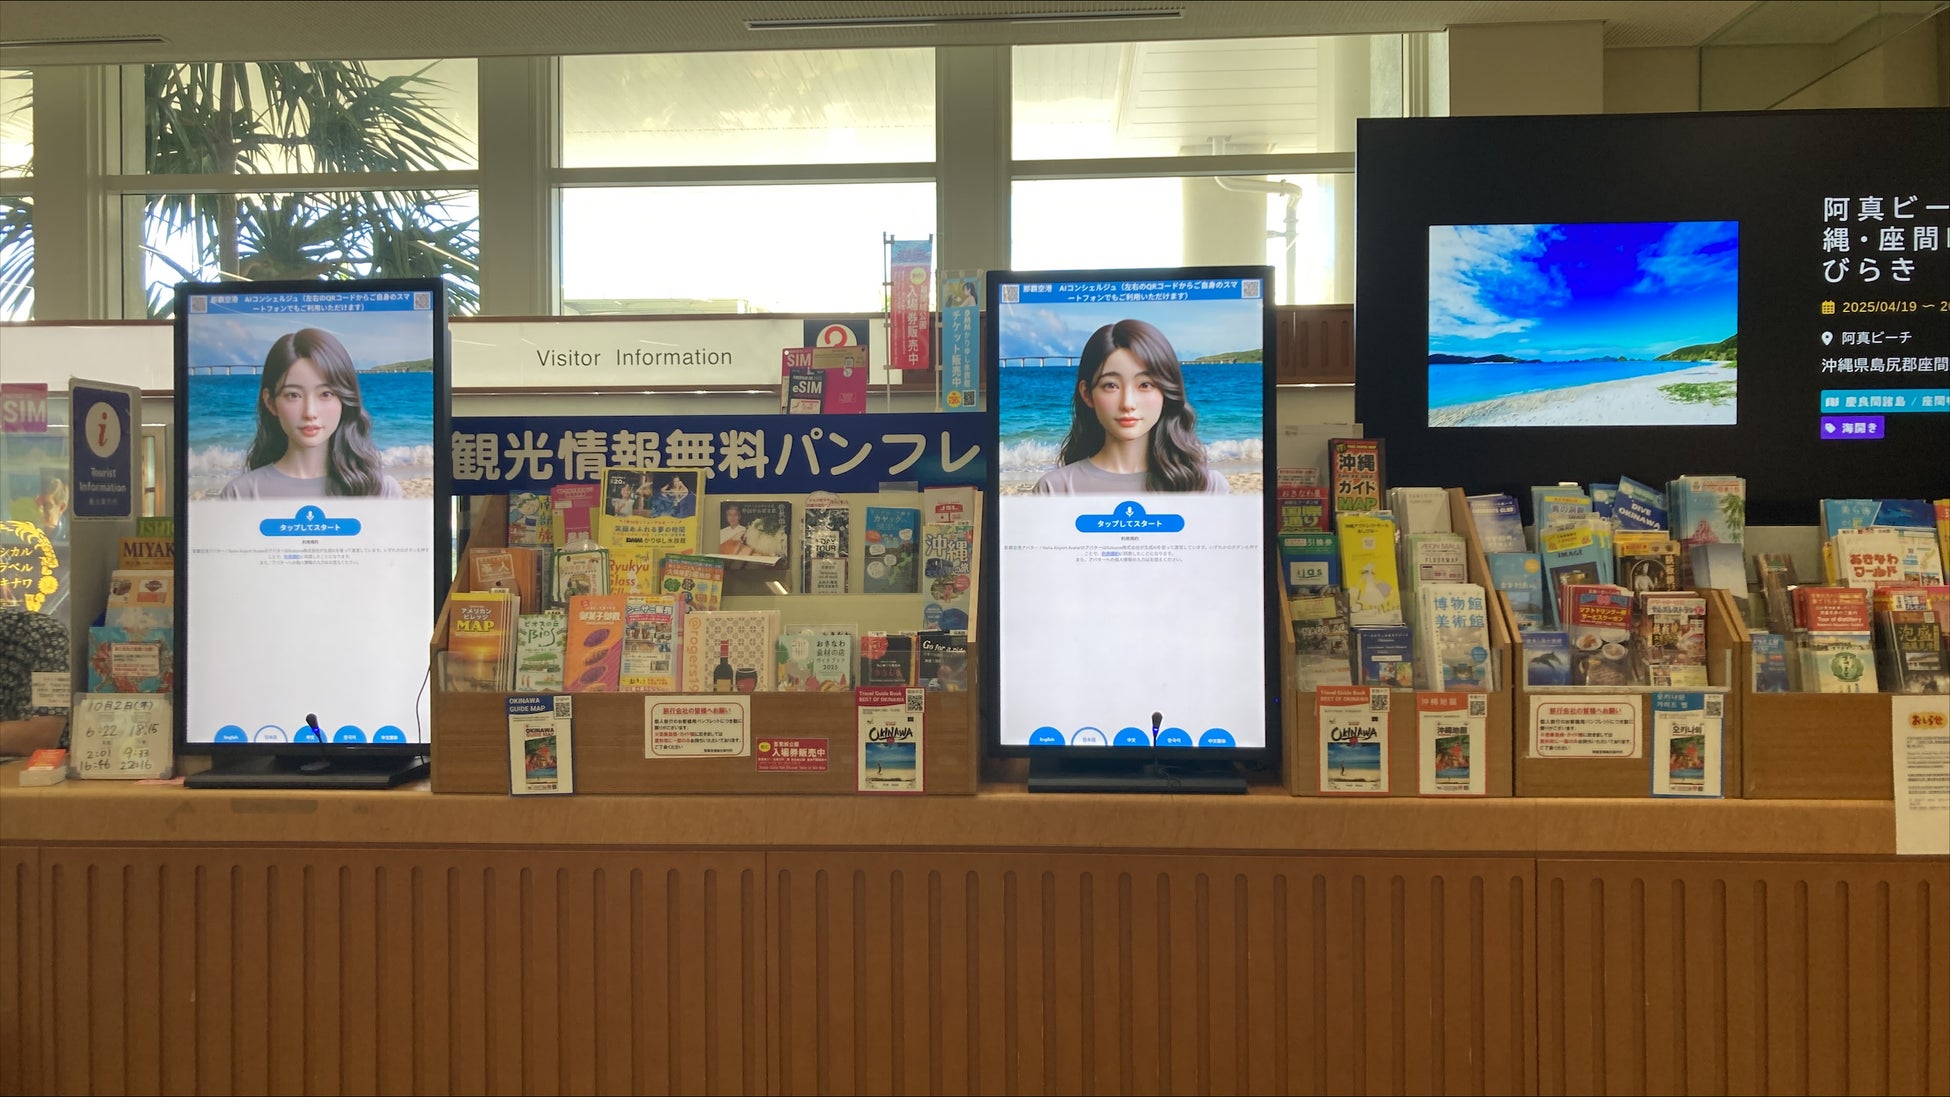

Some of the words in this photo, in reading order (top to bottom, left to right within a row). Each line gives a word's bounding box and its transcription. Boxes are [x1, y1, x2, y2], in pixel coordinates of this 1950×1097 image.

[1824, 195, 1950, 222] 阿真ビー
[1822, 226, 1950, 253] 縄・座間
[1822, 257, 1916, 283] びらき
[1842, 301, 1918, 314] 2025/04/19
[1940, 300, 1950, 312] 2
[907, 285, 919, 365] 入場券販売中
[1842, 331, 1912, 345] 阿真ビーチ
[952, 310, 961, 387] チケット販売中
[536, 350, 600, 366] Visitor
[616, 348, 732, 366] Information
[787, 354, 812, 367] SIM
[792, 381, 822, 394] eSIM
[1845, 396, 1906, 408] 慶良間諸島
[1922, 395, 1950, 407] 座間
[3, 396, 47, 422] SIM
[1842, 422, 1878, 434] 海開き
[451, 427, 981, 481] 観光情報無料パンフレ
[1339, 454, 1376, 472] 沖縄
[90, 467, 116, 478] Tourist
[80, 482, 126, 492] Information
[1338, 480, 1376, 495] ガイド
[1338, 496, 1378, 512] MAP
[1631, 502, 1652, 516] DIVE
[1097, 520, 1163, 528] タップしてスタート
[1618, 507, 1660, 530] OKINAWA
[280, 524, 342, 532] タップしてスタート
[816, 544, 836, 552] TOUR
[925, 534, 968, 562] 沖縄
[1850, 553, 1900, 565] おきなわ
[610, 560, 649, 575] Ryukyu
[1854, 566, 1898, 578] ワールド
[1433, 597, 1483, 610] 博物館
[1435, 614, 1485, 628] 美術館
[1581, 614, 1624, 622] サービスクーポン
[456, 620, 495, 632] MAP
[1302, 626, 1330, 635] NAGO
[1899, 624, 1934, 642] 泡盛
[817, 640, 846, 648] おきなわ
[922, 640, 934, 650] Go
[934, 644, 945, 652] for
[1912, 714, 1944, 726] おしらせ
[869, 727, 914, 742] OKINAWA
[1331, 726, 1378, 741] OKINAWA
[1672, 726, 1702, 734] 오키나와
[772, 748, 826, 758] 入場券販売中
